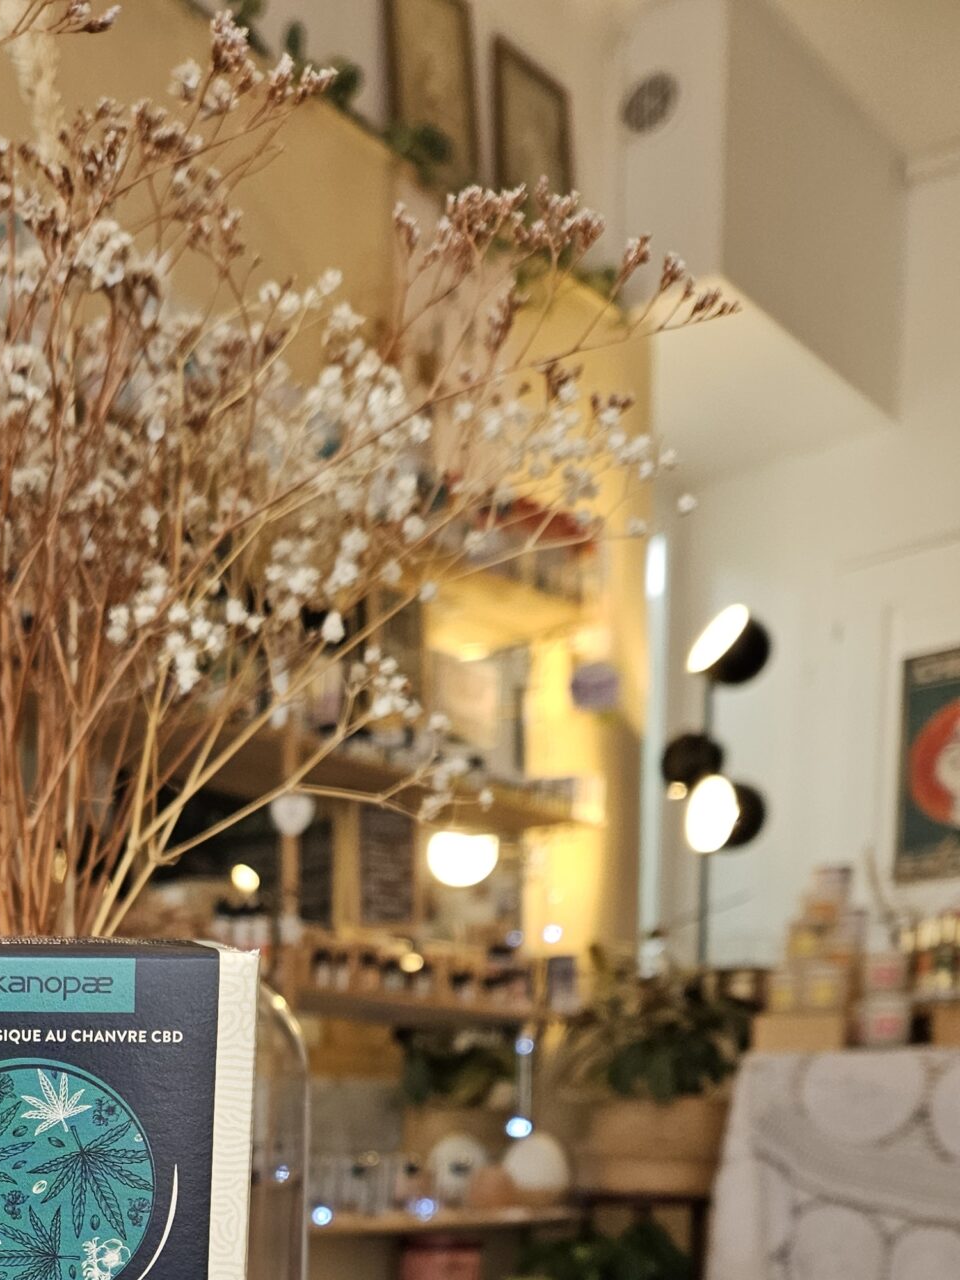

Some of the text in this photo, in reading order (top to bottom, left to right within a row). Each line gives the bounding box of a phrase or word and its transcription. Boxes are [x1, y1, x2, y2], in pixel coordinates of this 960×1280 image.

[45, 1029, 68, 1043] AU
[71, 1029, 147, 1043] CHANVRE
[151, 1030, 184, 1044] CBD
